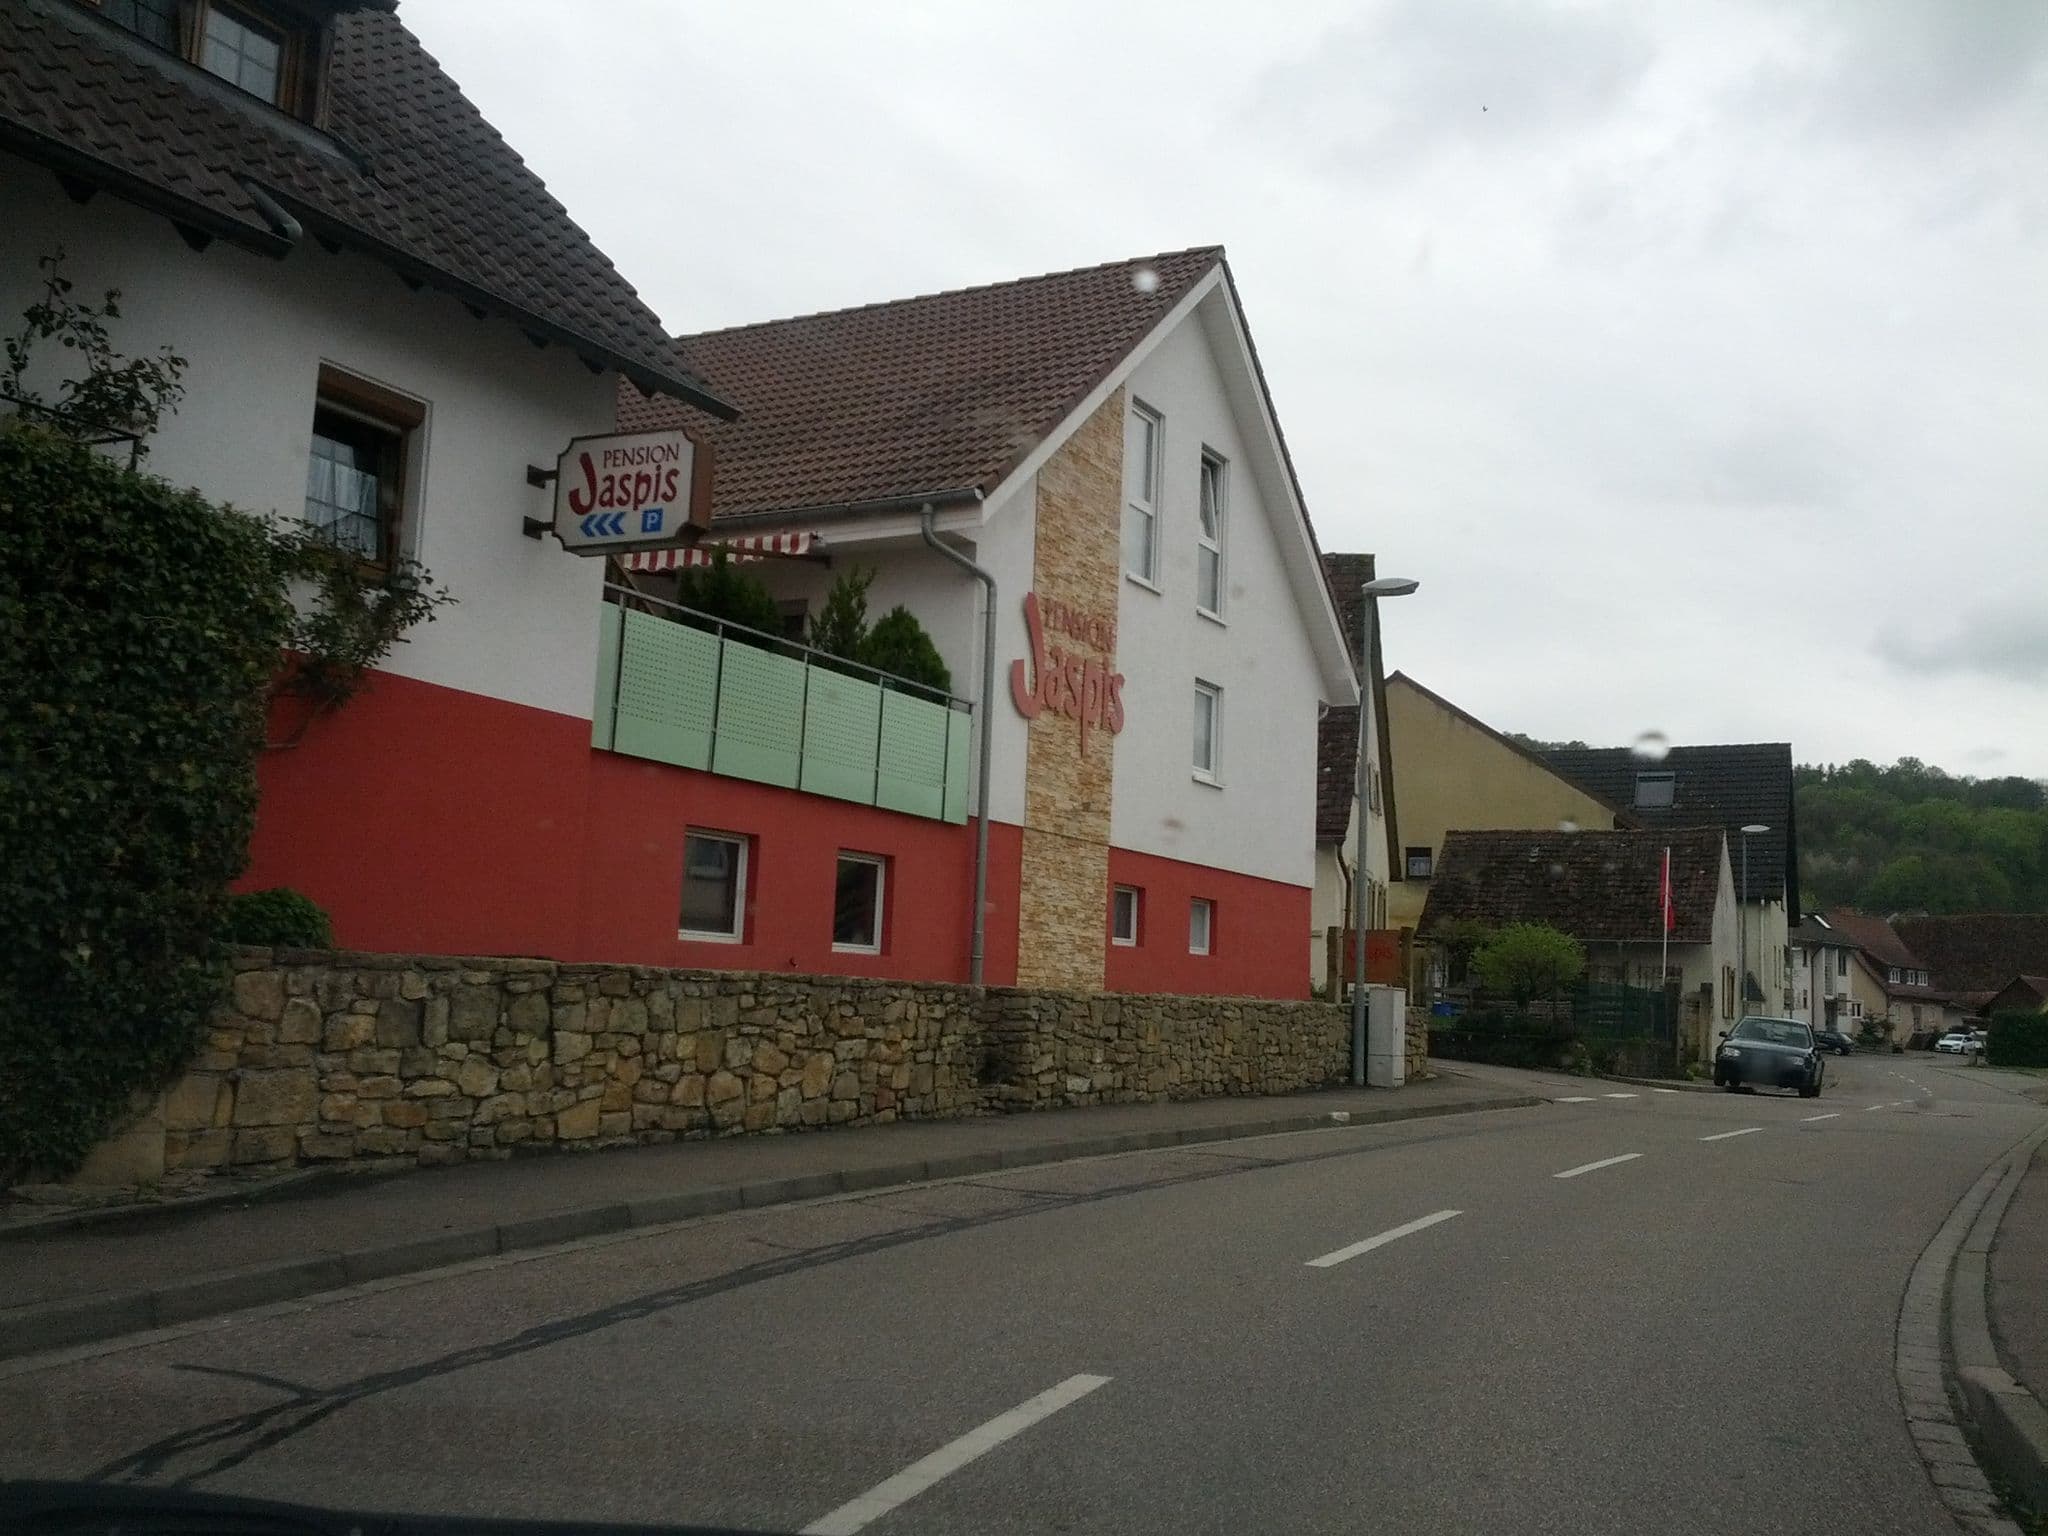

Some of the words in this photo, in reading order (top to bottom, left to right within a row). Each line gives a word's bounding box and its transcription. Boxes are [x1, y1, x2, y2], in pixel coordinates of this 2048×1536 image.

[568, 452, 681, 516] Jaspis
[603, 443, 680, 469] PENSION
[1010, 592, 1125, 758] Jaspis
